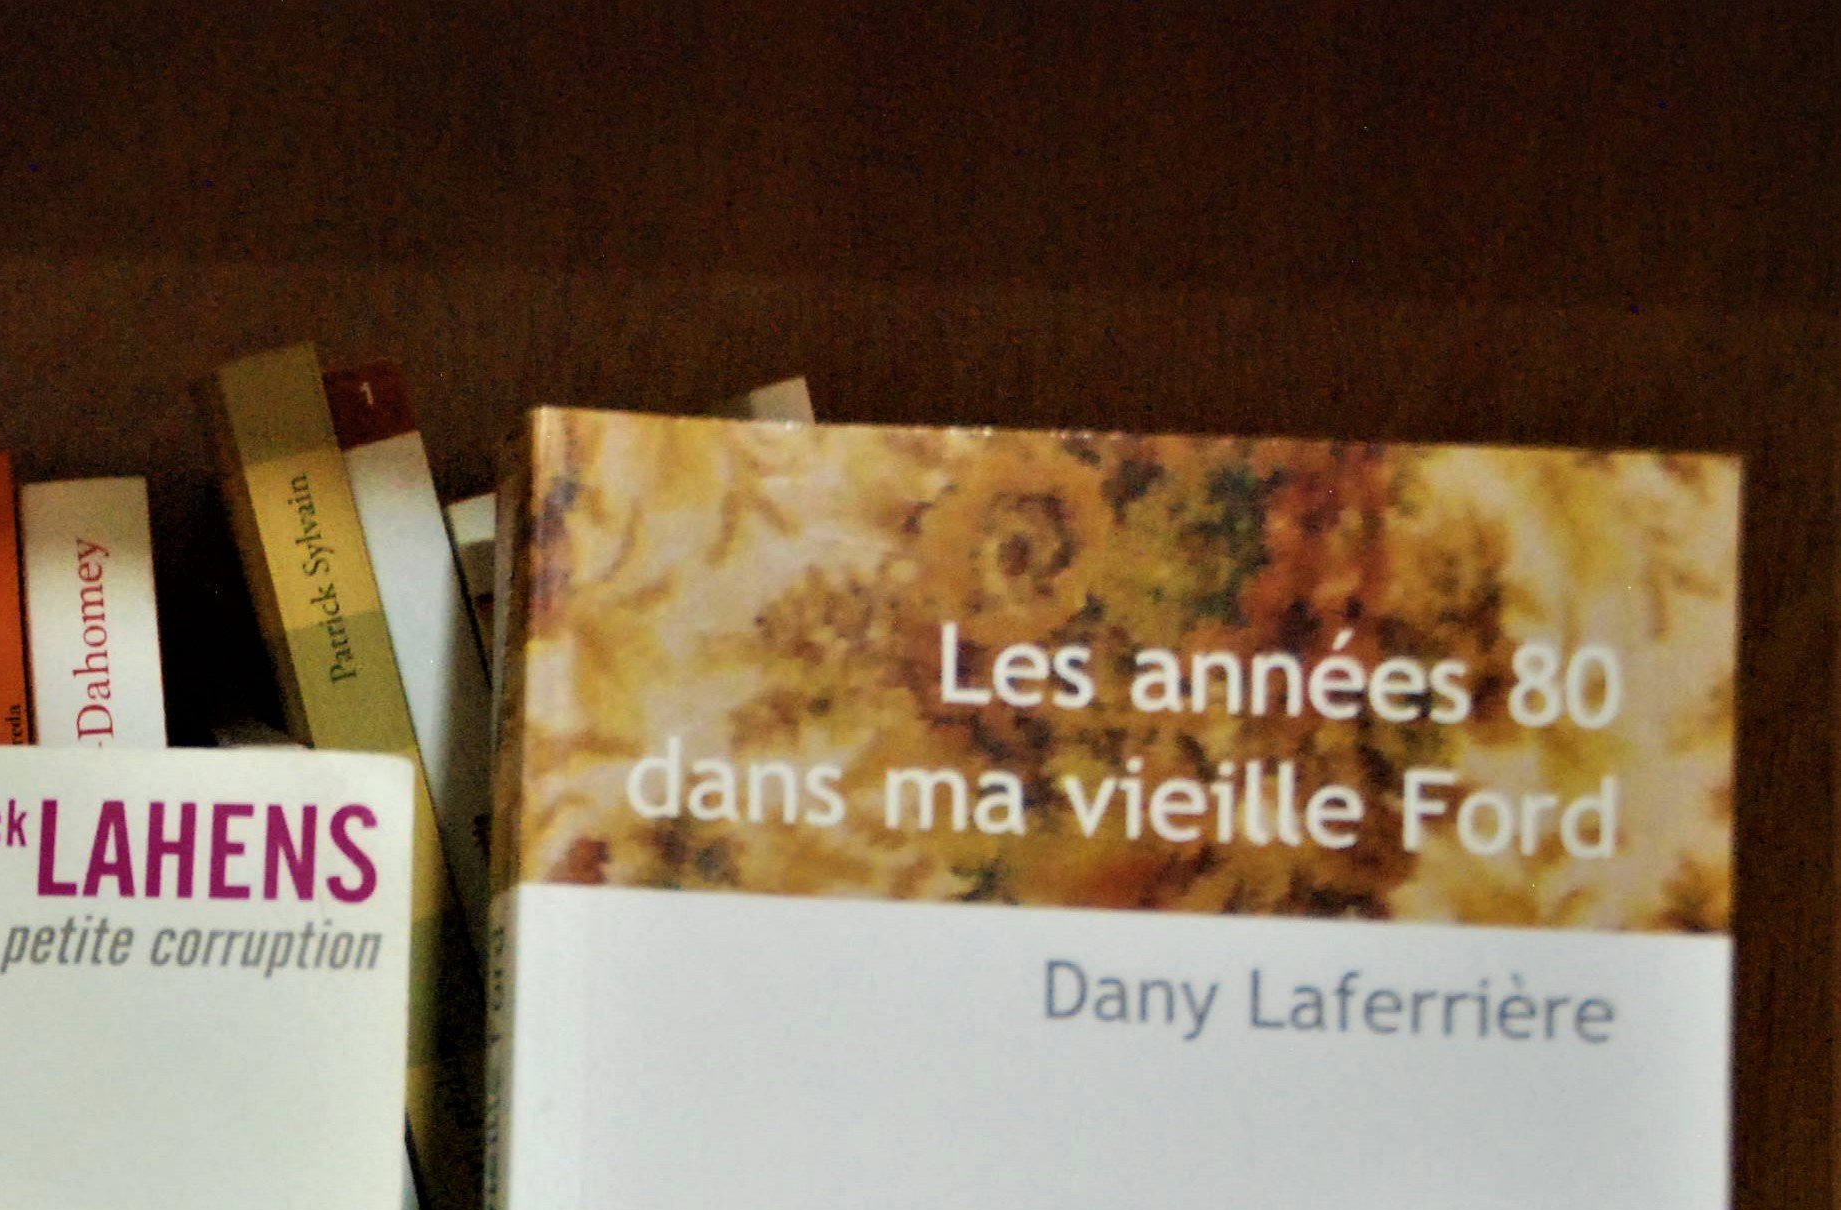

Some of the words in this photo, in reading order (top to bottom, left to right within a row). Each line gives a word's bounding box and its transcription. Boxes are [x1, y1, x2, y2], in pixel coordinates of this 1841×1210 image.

[286, 471, 335, 577] Sylvain
[310, 581, 358, 685] Patrick
[938, 621, 1094, 709] Les
[1127, 627, 1473, 723] années
[1506, 643, 1623, 731] 80
[625, 734, 847, 829] dans
[883, 764, 1028, 838] ma
[1063, 757, 1365, 852] vieille
[1401, 769, 1621, 861] Ford
[35, 796, 380, 906] LAHENS
[147, 917, 385, 979] corruption
[1042, 959, 1220, 1042] Dany
[1248, 968, 1618, 1047] Laferrière
